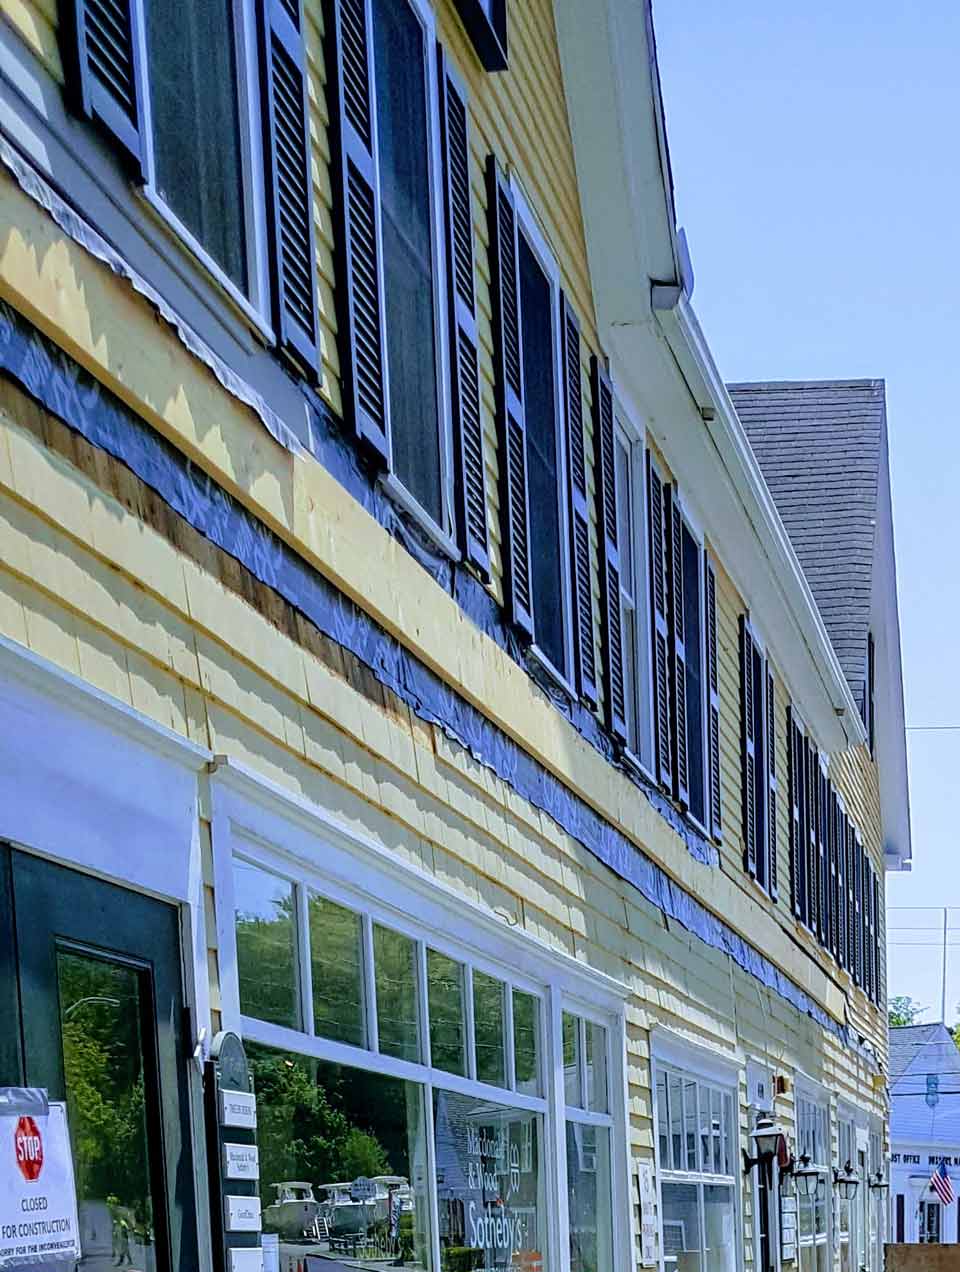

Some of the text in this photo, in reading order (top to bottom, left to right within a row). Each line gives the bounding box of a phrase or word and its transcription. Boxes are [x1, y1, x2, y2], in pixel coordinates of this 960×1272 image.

[17, 1135, 40, 1161] STOP
[890, 1153, 901, 1164] OST
[903, 1154, 921, 1165] OFFICE
[476, 1161, 498, 1191] Wood
[21, 1196, 48, 1212] CLOSED
[2, 1217, 71, 1239] FOR CONSTRUCTION
[469, 1200, 522, 1265] Sotheby's
[0, 1247, 14, 1257] ORRY
[15, 1246, 26, 1255] FOR
[28, 1244, 38, 1253] THE
